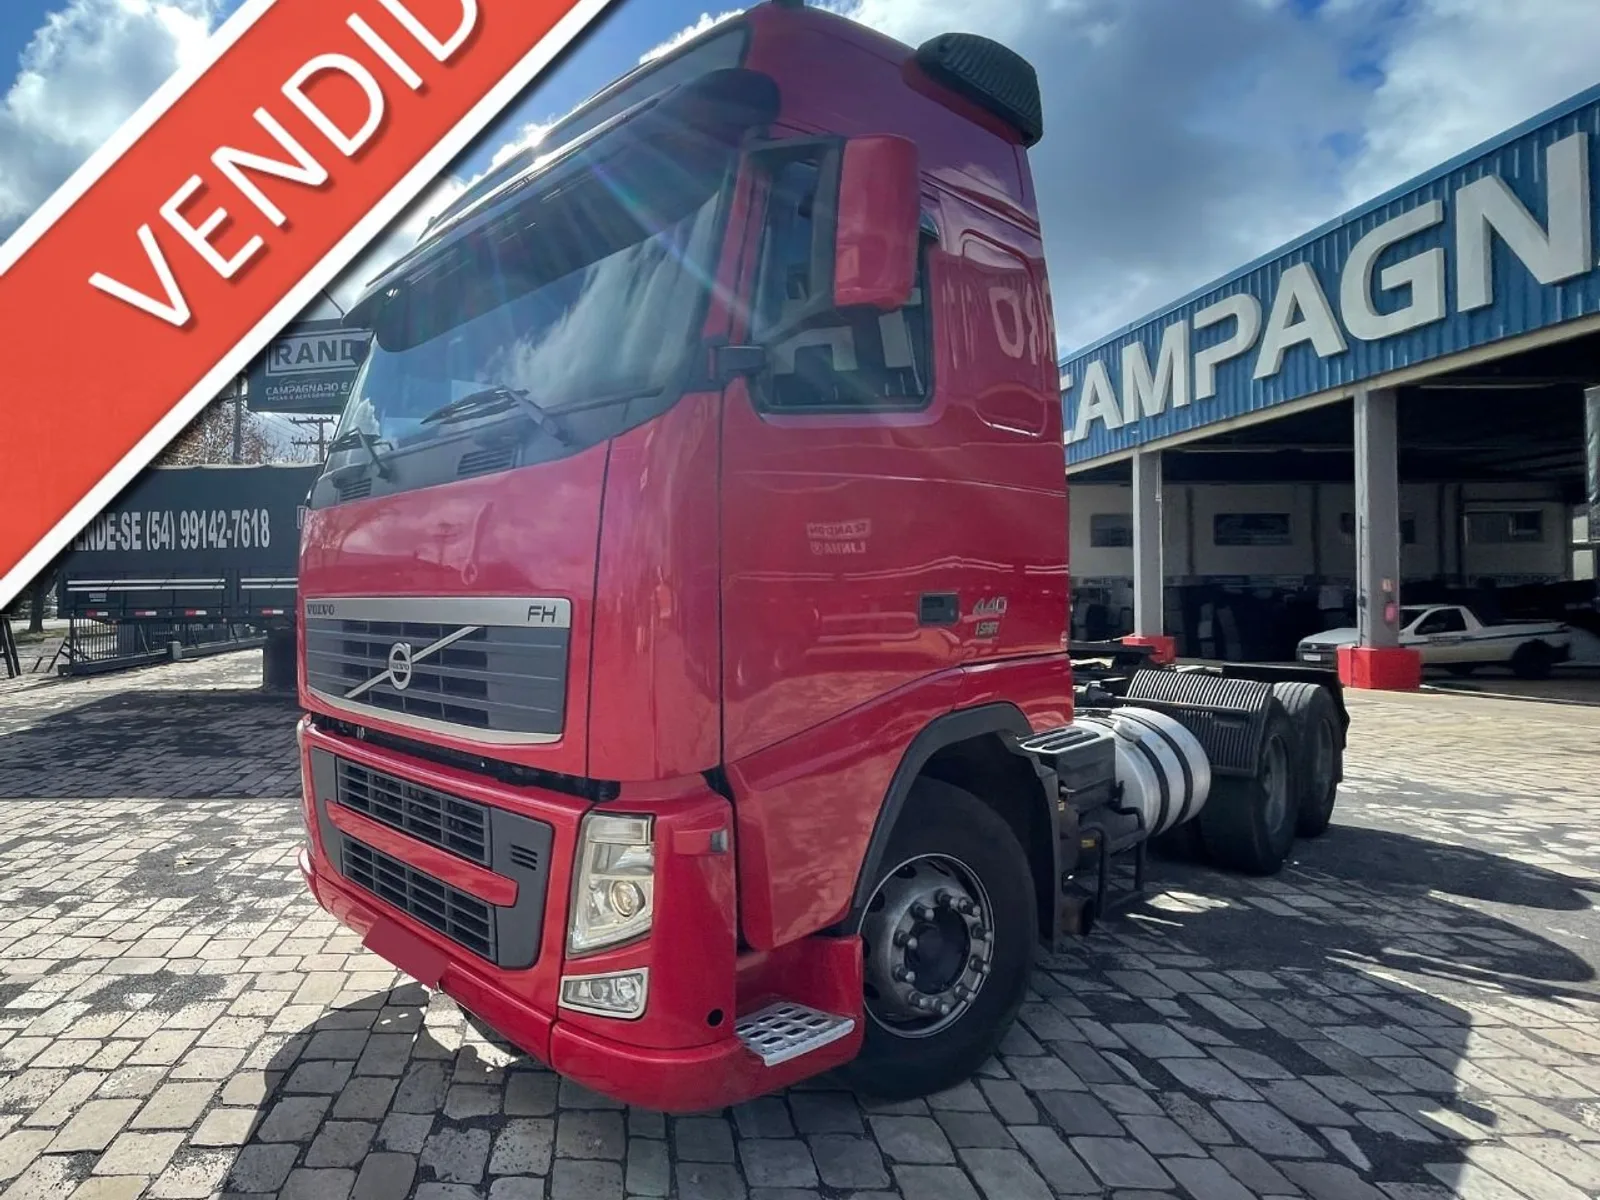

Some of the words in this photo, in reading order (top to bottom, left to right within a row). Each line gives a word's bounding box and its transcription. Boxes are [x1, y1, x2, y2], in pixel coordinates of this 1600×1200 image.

[1061, 131, 1592, 445] AMPAGN
[265, 382, 339, 396] CAMPAGNARO
[71, 512, 141, 551] NDE-SE
[145, 509, 176, 551] (54)
[180, 508, 271, 550] 99142-7618
[306, 603, 336, 617] VOLVO
[527, 604, 557, 623] FH
